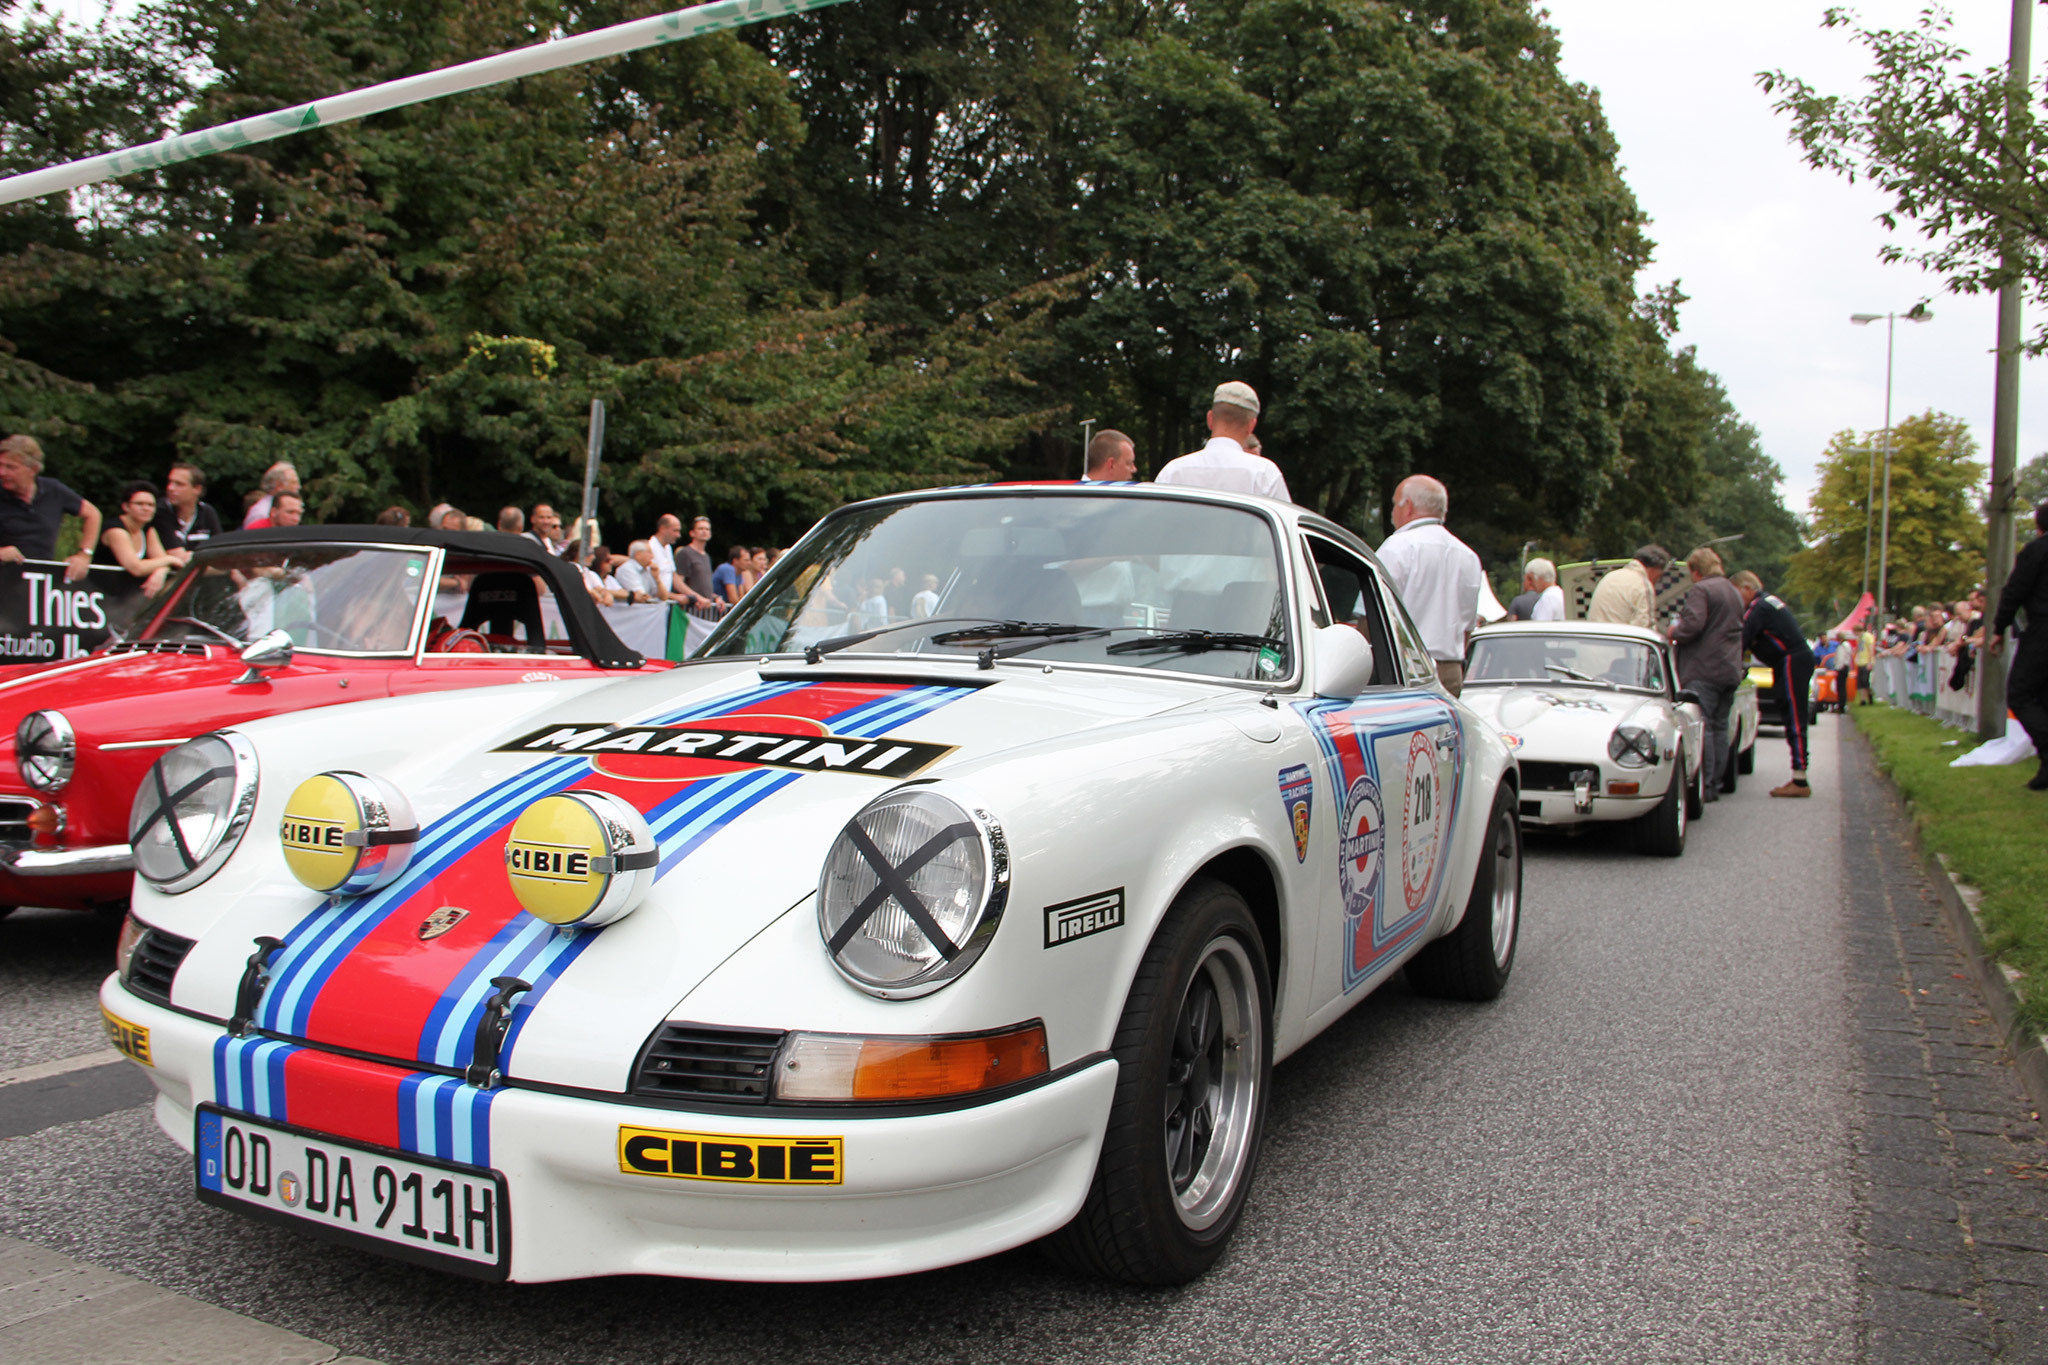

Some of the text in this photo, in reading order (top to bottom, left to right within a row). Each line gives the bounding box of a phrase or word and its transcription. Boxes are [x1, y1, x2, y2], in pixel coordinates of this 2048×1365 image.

[22, 572, 106, 629] Thies
[524, 727, 914, 771] MARTINI
[1414, 772, 1432, 826] 218
[1048, 893, 1120, 943] PIRELLI
[224, 1125, 272, 1197] OD
[305, 1146, 358, 1223] DA
[373, 1164, 494, 1255] 911H
